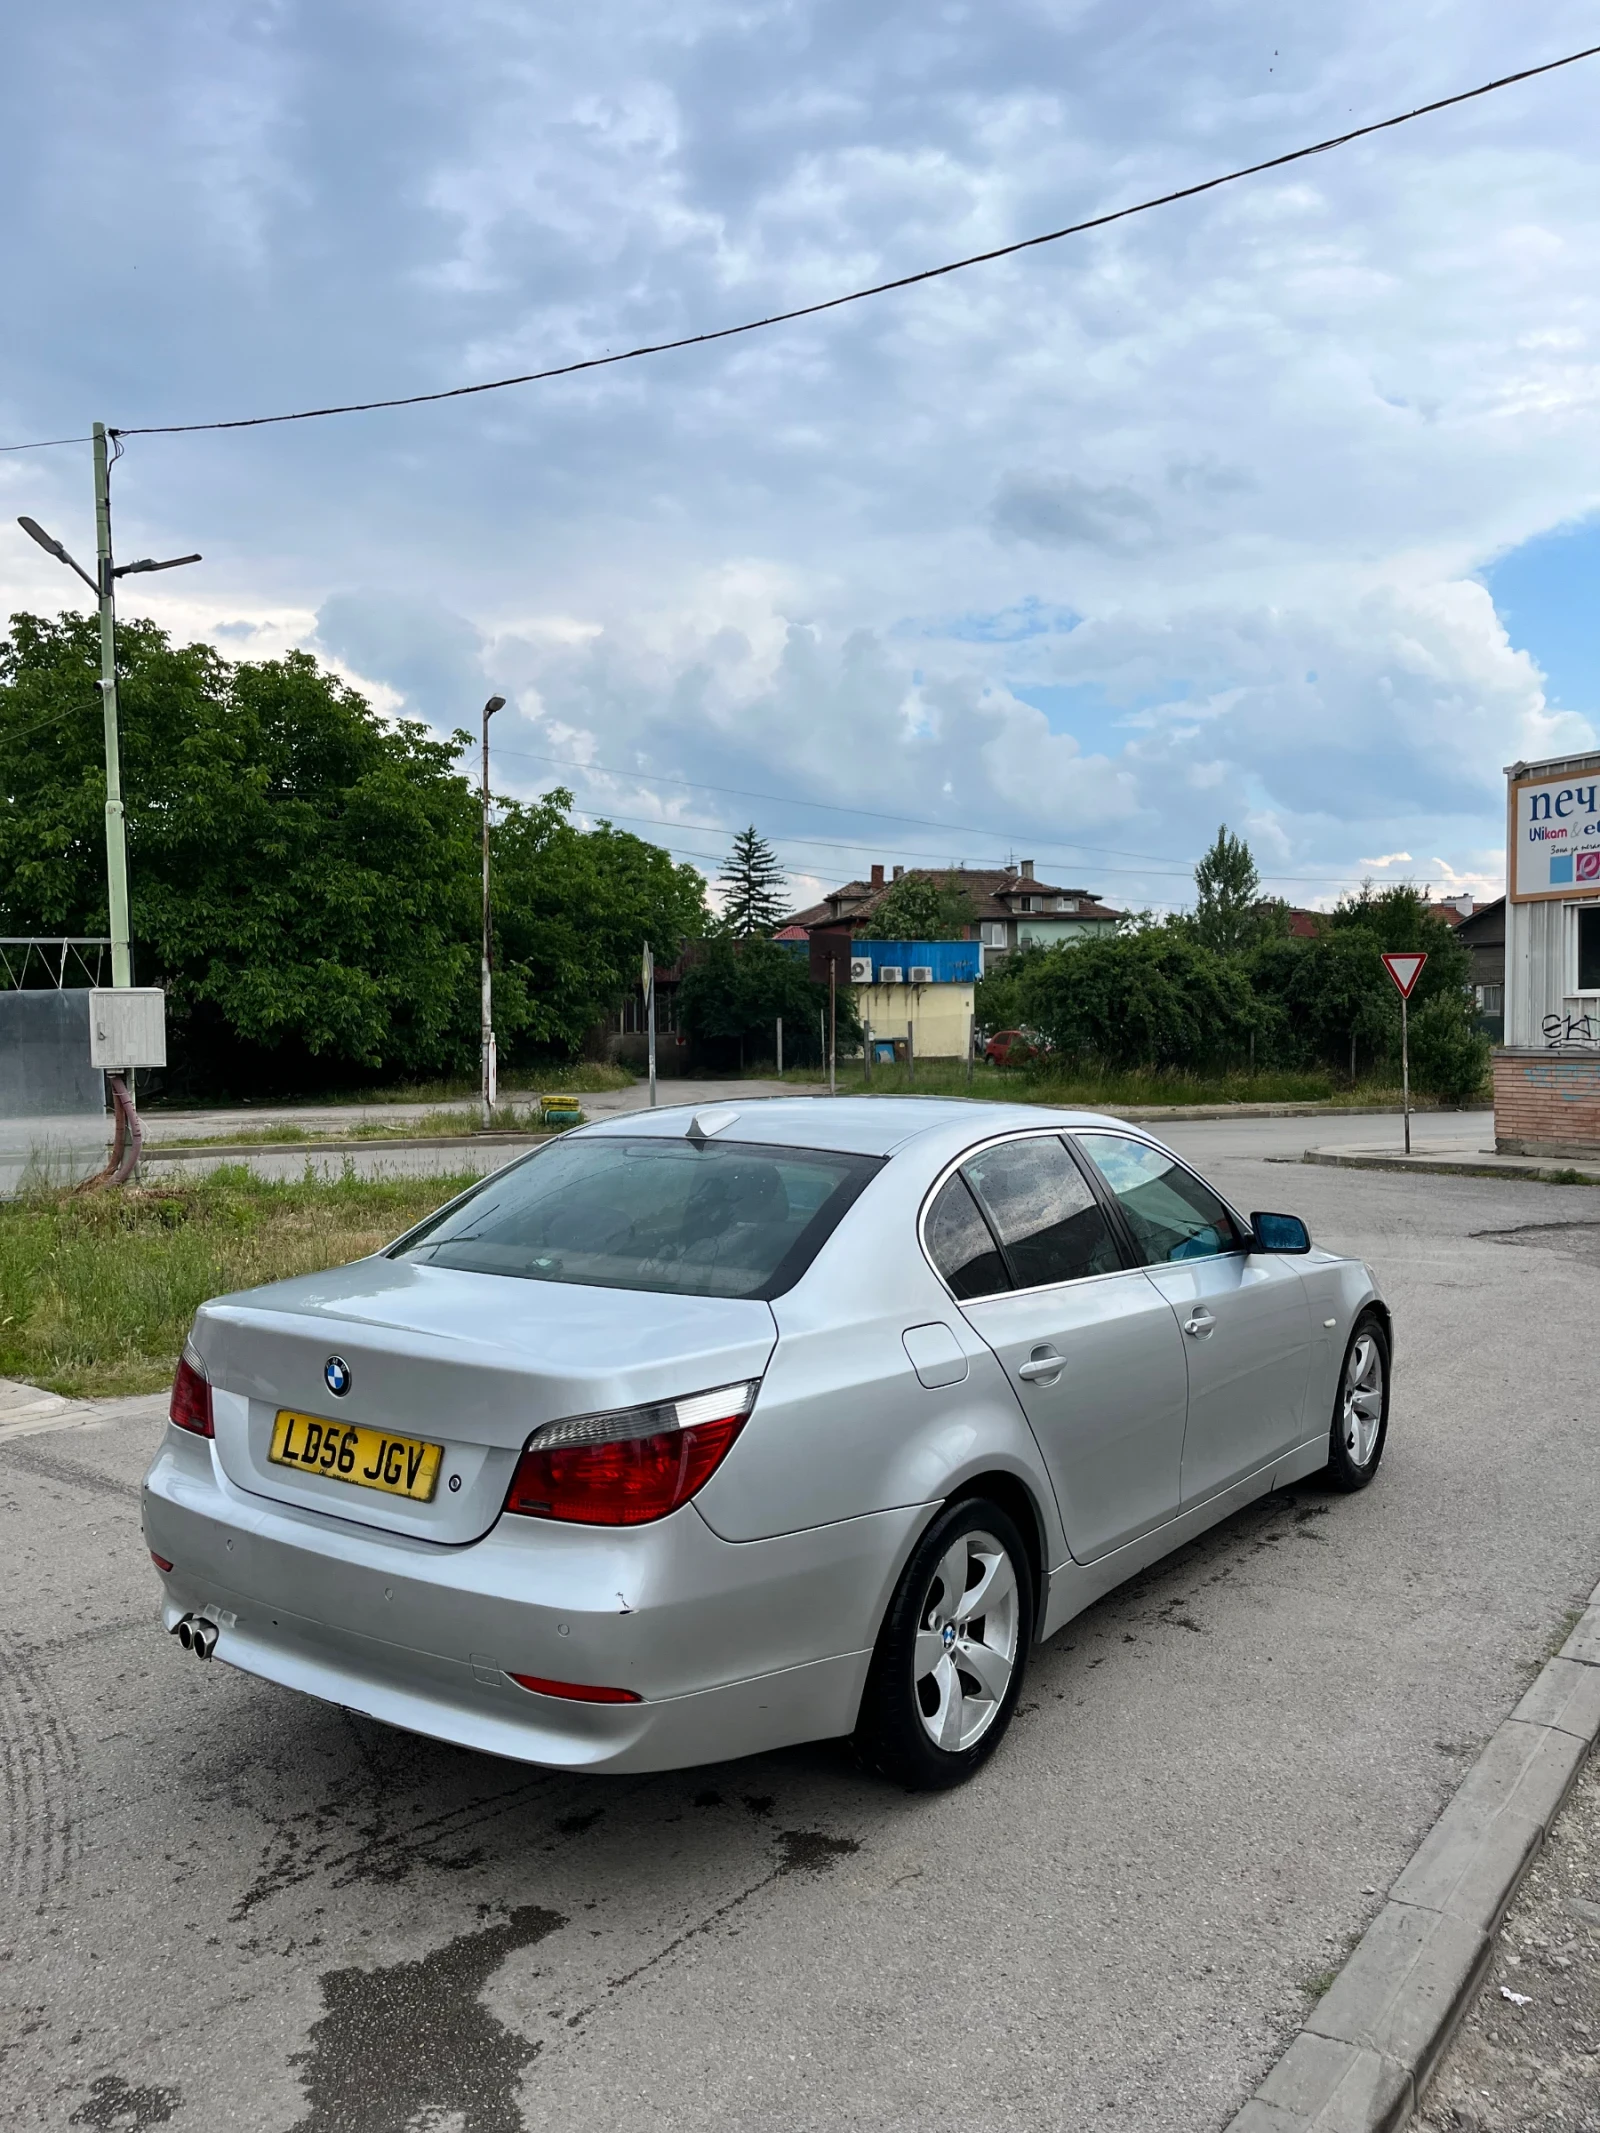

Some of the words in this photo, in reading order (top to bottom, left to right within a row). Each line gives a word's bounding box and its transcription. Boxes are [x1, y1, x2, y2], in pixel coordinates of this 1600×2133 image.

[1529, 785, 1600, 822] печ
[1570, 821, 1582, 838] &
[363, 1440, 426, 1490] JGV
